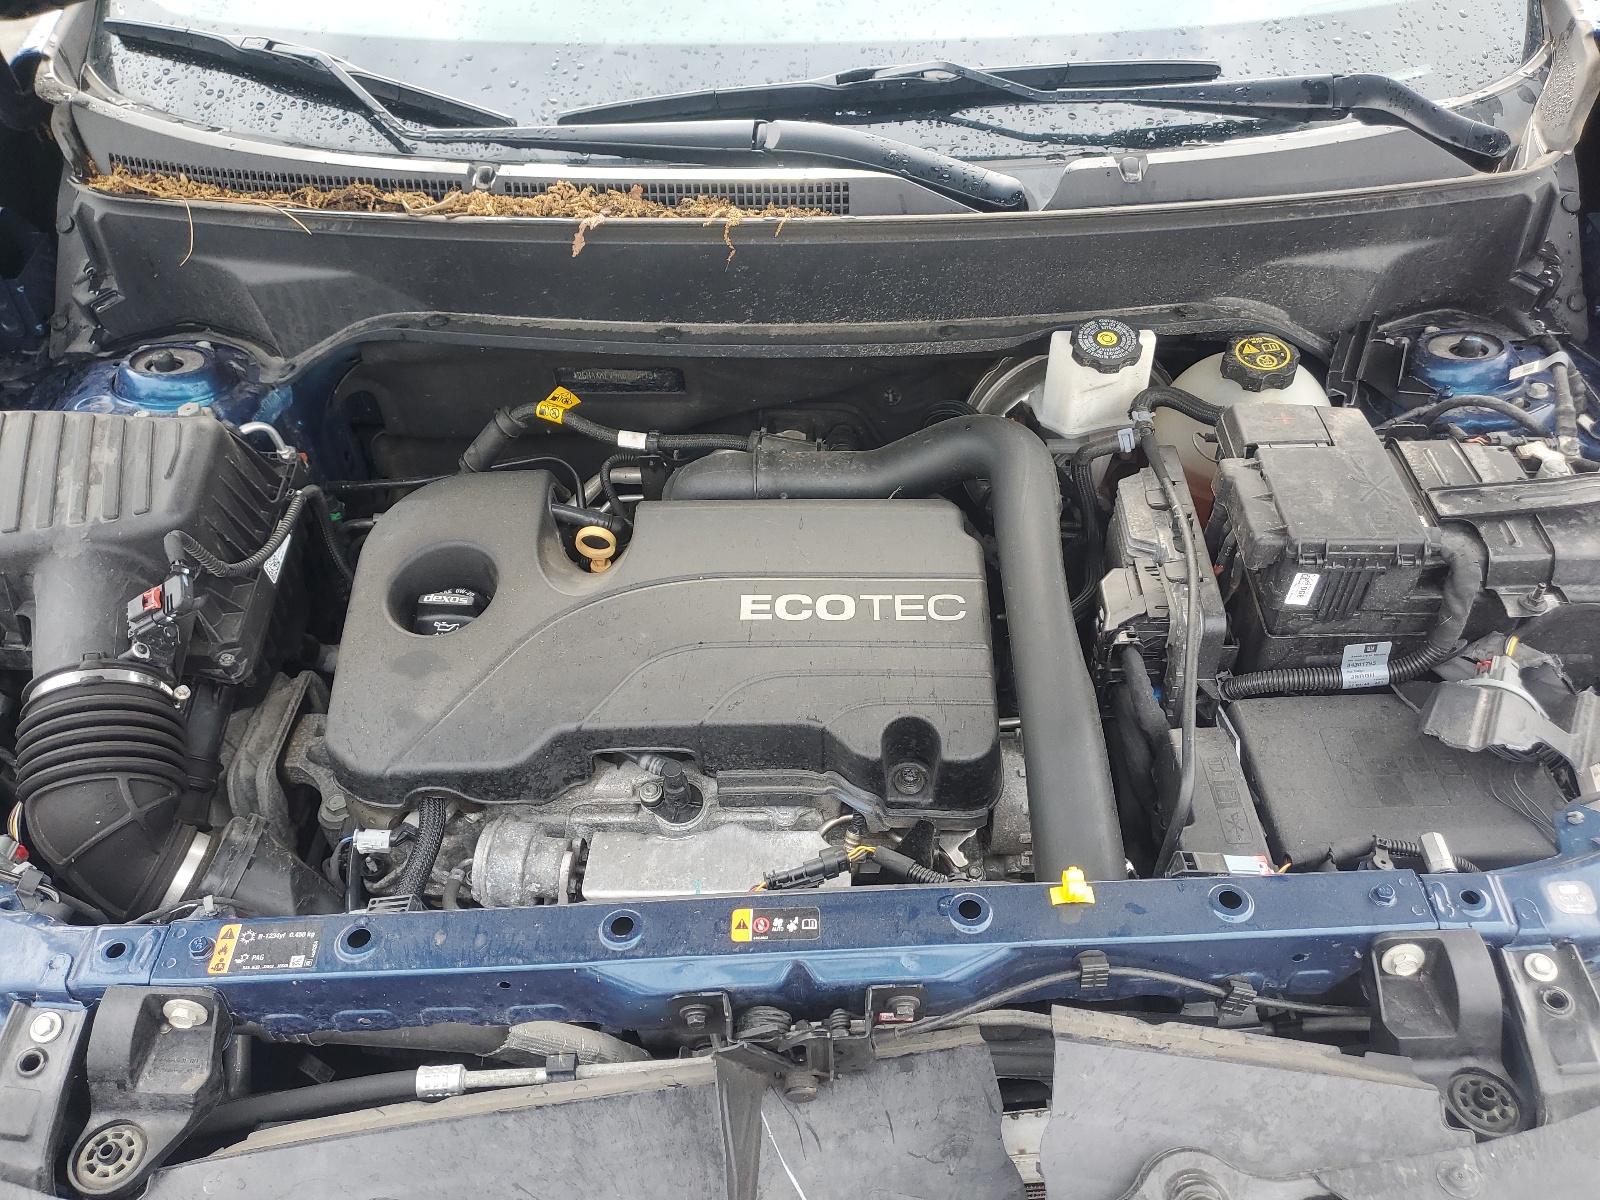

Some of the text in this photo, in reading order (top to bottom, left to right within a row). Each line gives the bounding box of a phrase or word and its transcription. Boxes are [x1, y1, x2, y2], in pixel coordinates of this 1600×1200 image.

[455, 587, 475, 597] 0W-20
[423, 594, 468, 604] dexos
[740, 594, 966, 621] ECOTEC
[257, 932, 287, 940] R-1234yf
[307, 930, 315, 938] kg
